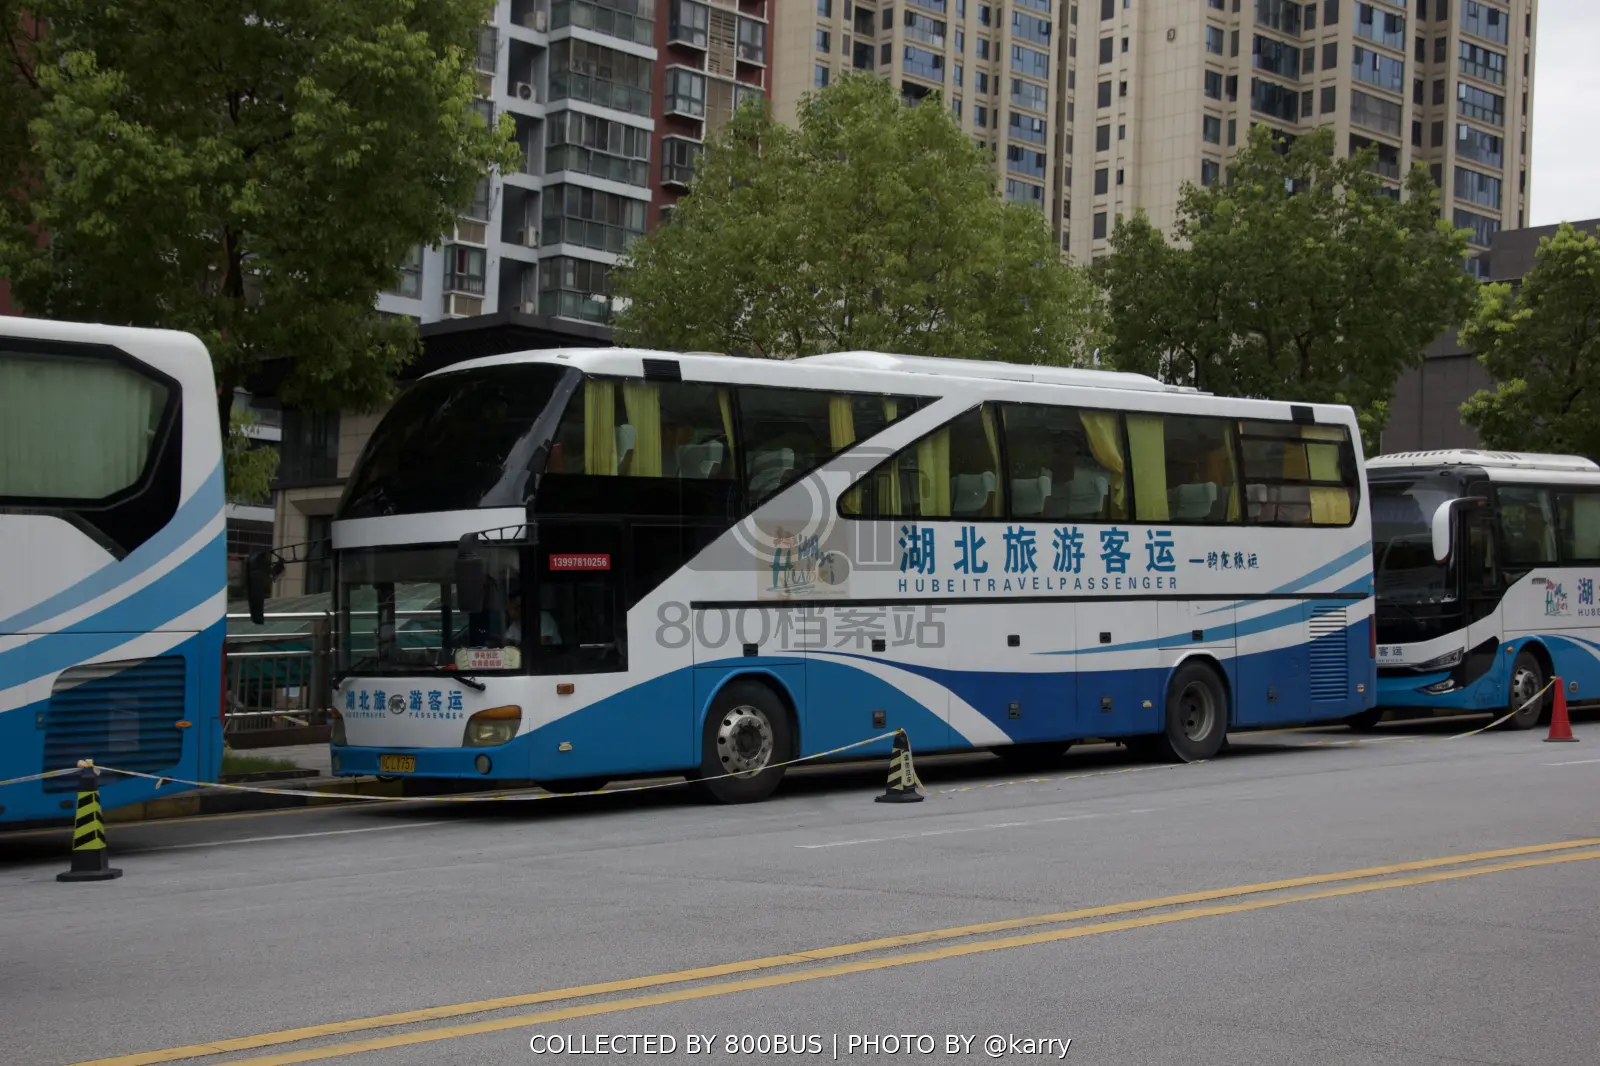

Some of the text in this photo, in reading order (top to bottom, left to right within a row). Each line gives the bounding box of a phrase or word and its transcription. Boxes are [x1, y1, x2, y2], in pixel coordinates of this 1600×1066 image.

[553, 557, 607, 567] 13997810256
[898, 525, 1178, 575] 湖北旅游客运
[1578, 577, 1600, 605] 湖
